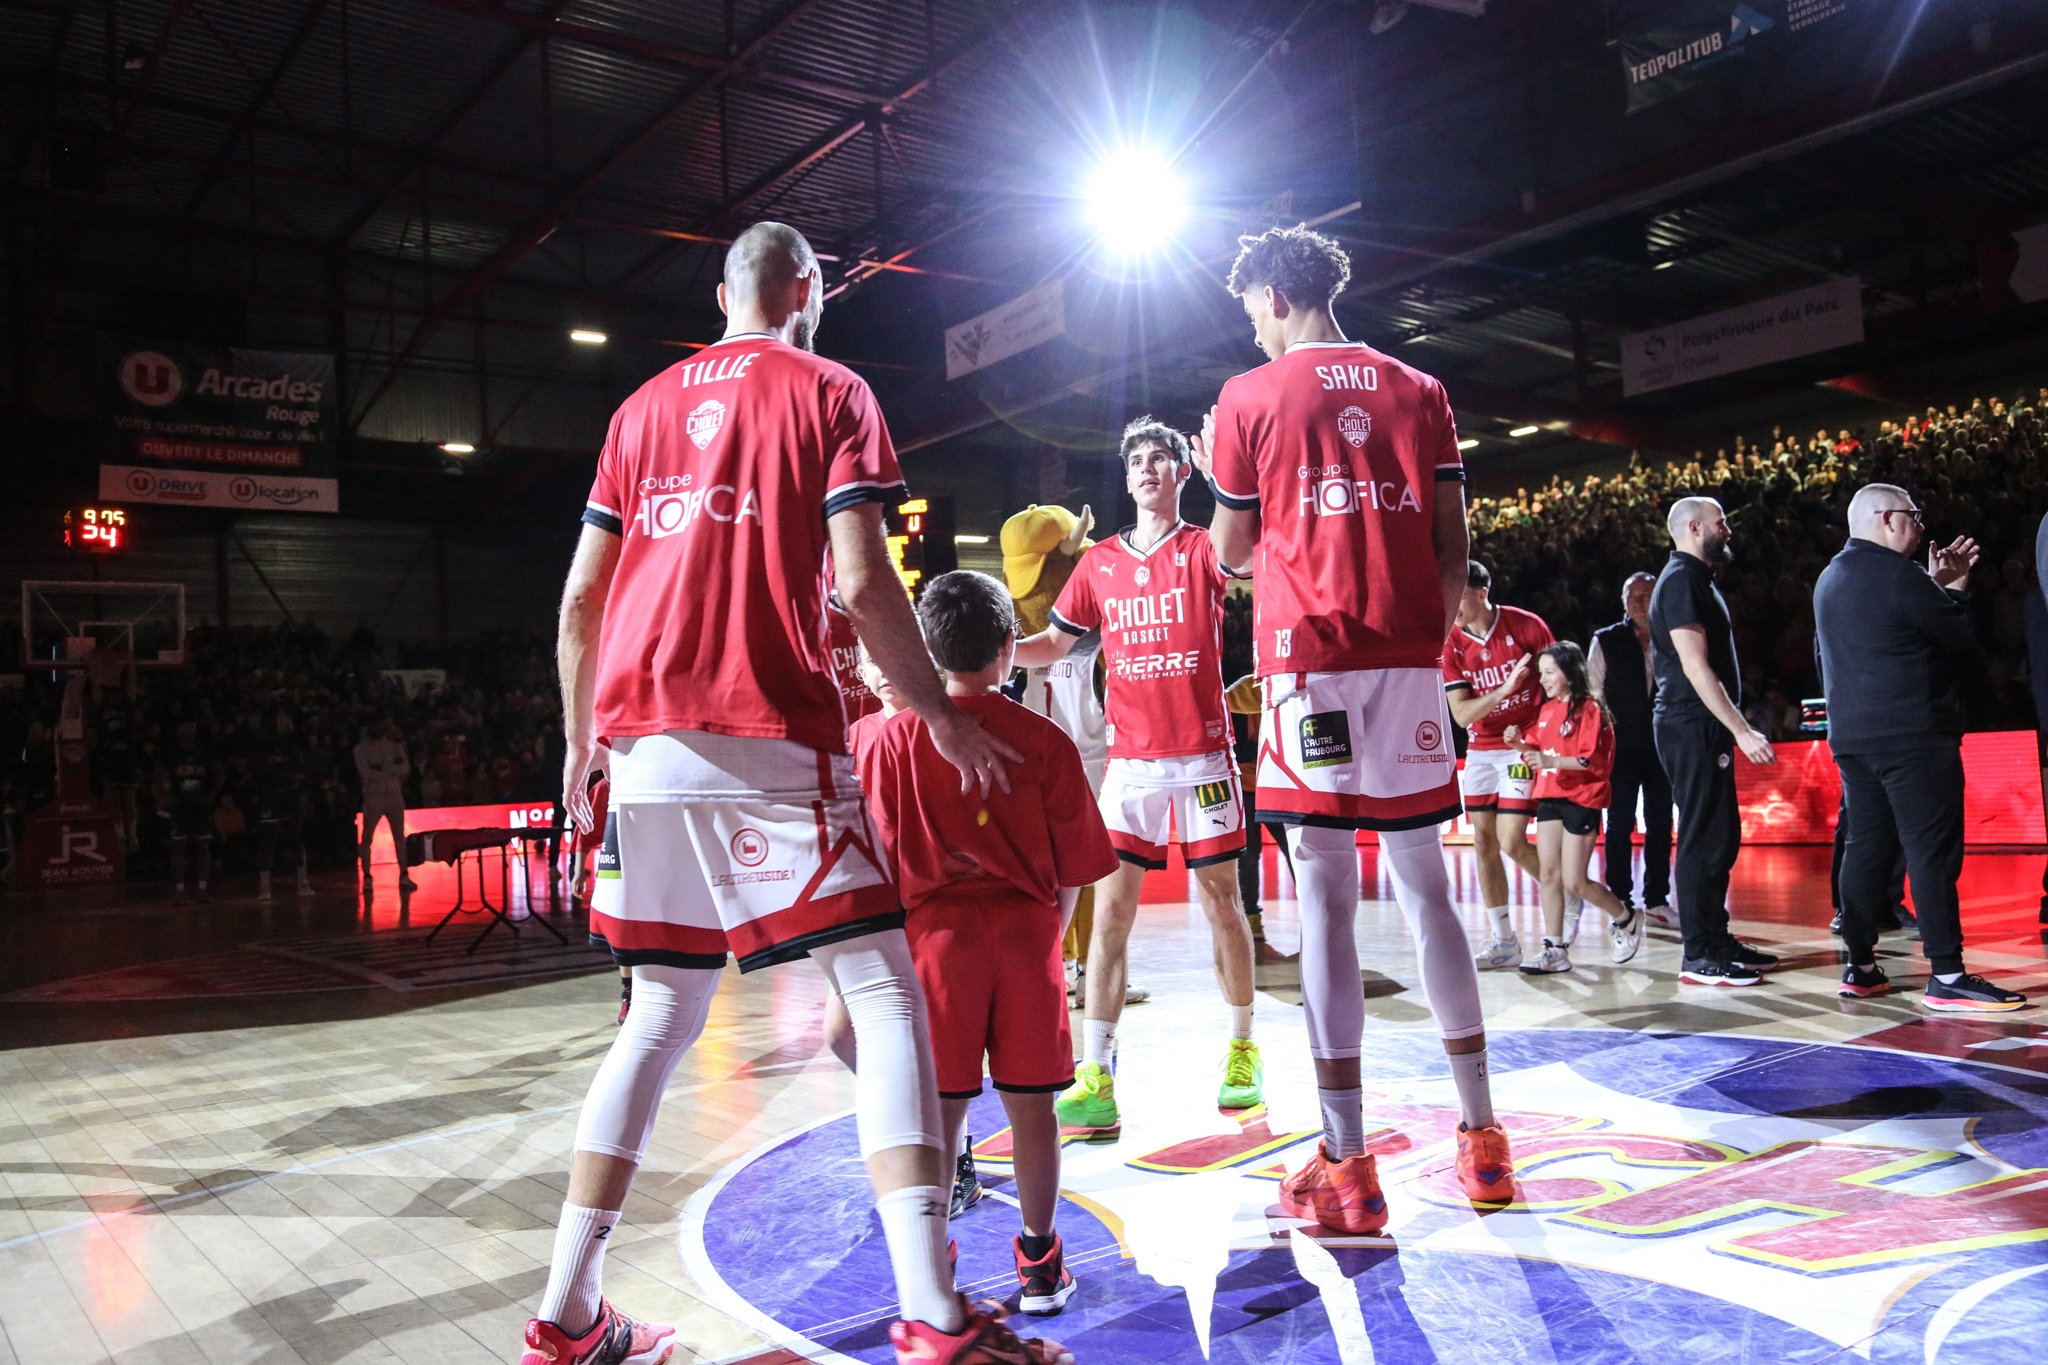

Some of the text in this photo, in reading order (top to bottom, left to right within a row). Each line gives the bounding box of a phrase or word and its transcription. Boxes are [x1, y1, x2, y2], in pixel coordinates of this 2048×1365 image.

[1630, 32, 1723, 84] TEOPOLITUB
[1681, 297, 1841, 349] Polyclinique du Parc
[134, 363, 170, 395] U
[681, 352, 761, 388] TILLIE
[1315, 364, 1378, 391] SAKO
[196, 368, 323, 403] Arcades
[114, 414, 152, 430] Votre
[265, 405, 321, 426] Rouge
[686, 409, 726, 434] CHOLET
[1337, 416, 1372, 432] CHOLET
[142, 442, 301, 465] OUVERT LE DIMANCHE
[1298, 464, 1349, 478] Groupe
[158, 478, 209, 493] DRIVE
[259, 485, 320, 500] location
[1299, 478, 1422, 517] HOFICA
[1104, 587, 1186, 632] CHOLET
[1122, 626, 1169, 645] BASKET
[1274, 628, 1292, 658] 13
[1304, 736, 1334, 748] L'AUTRE
[1305, 743, 1347, 757] FAUBOURG
[1204, 803, 1228, 814] CHOLET
[41, 864, 114, 879] JEAN ROUYER
